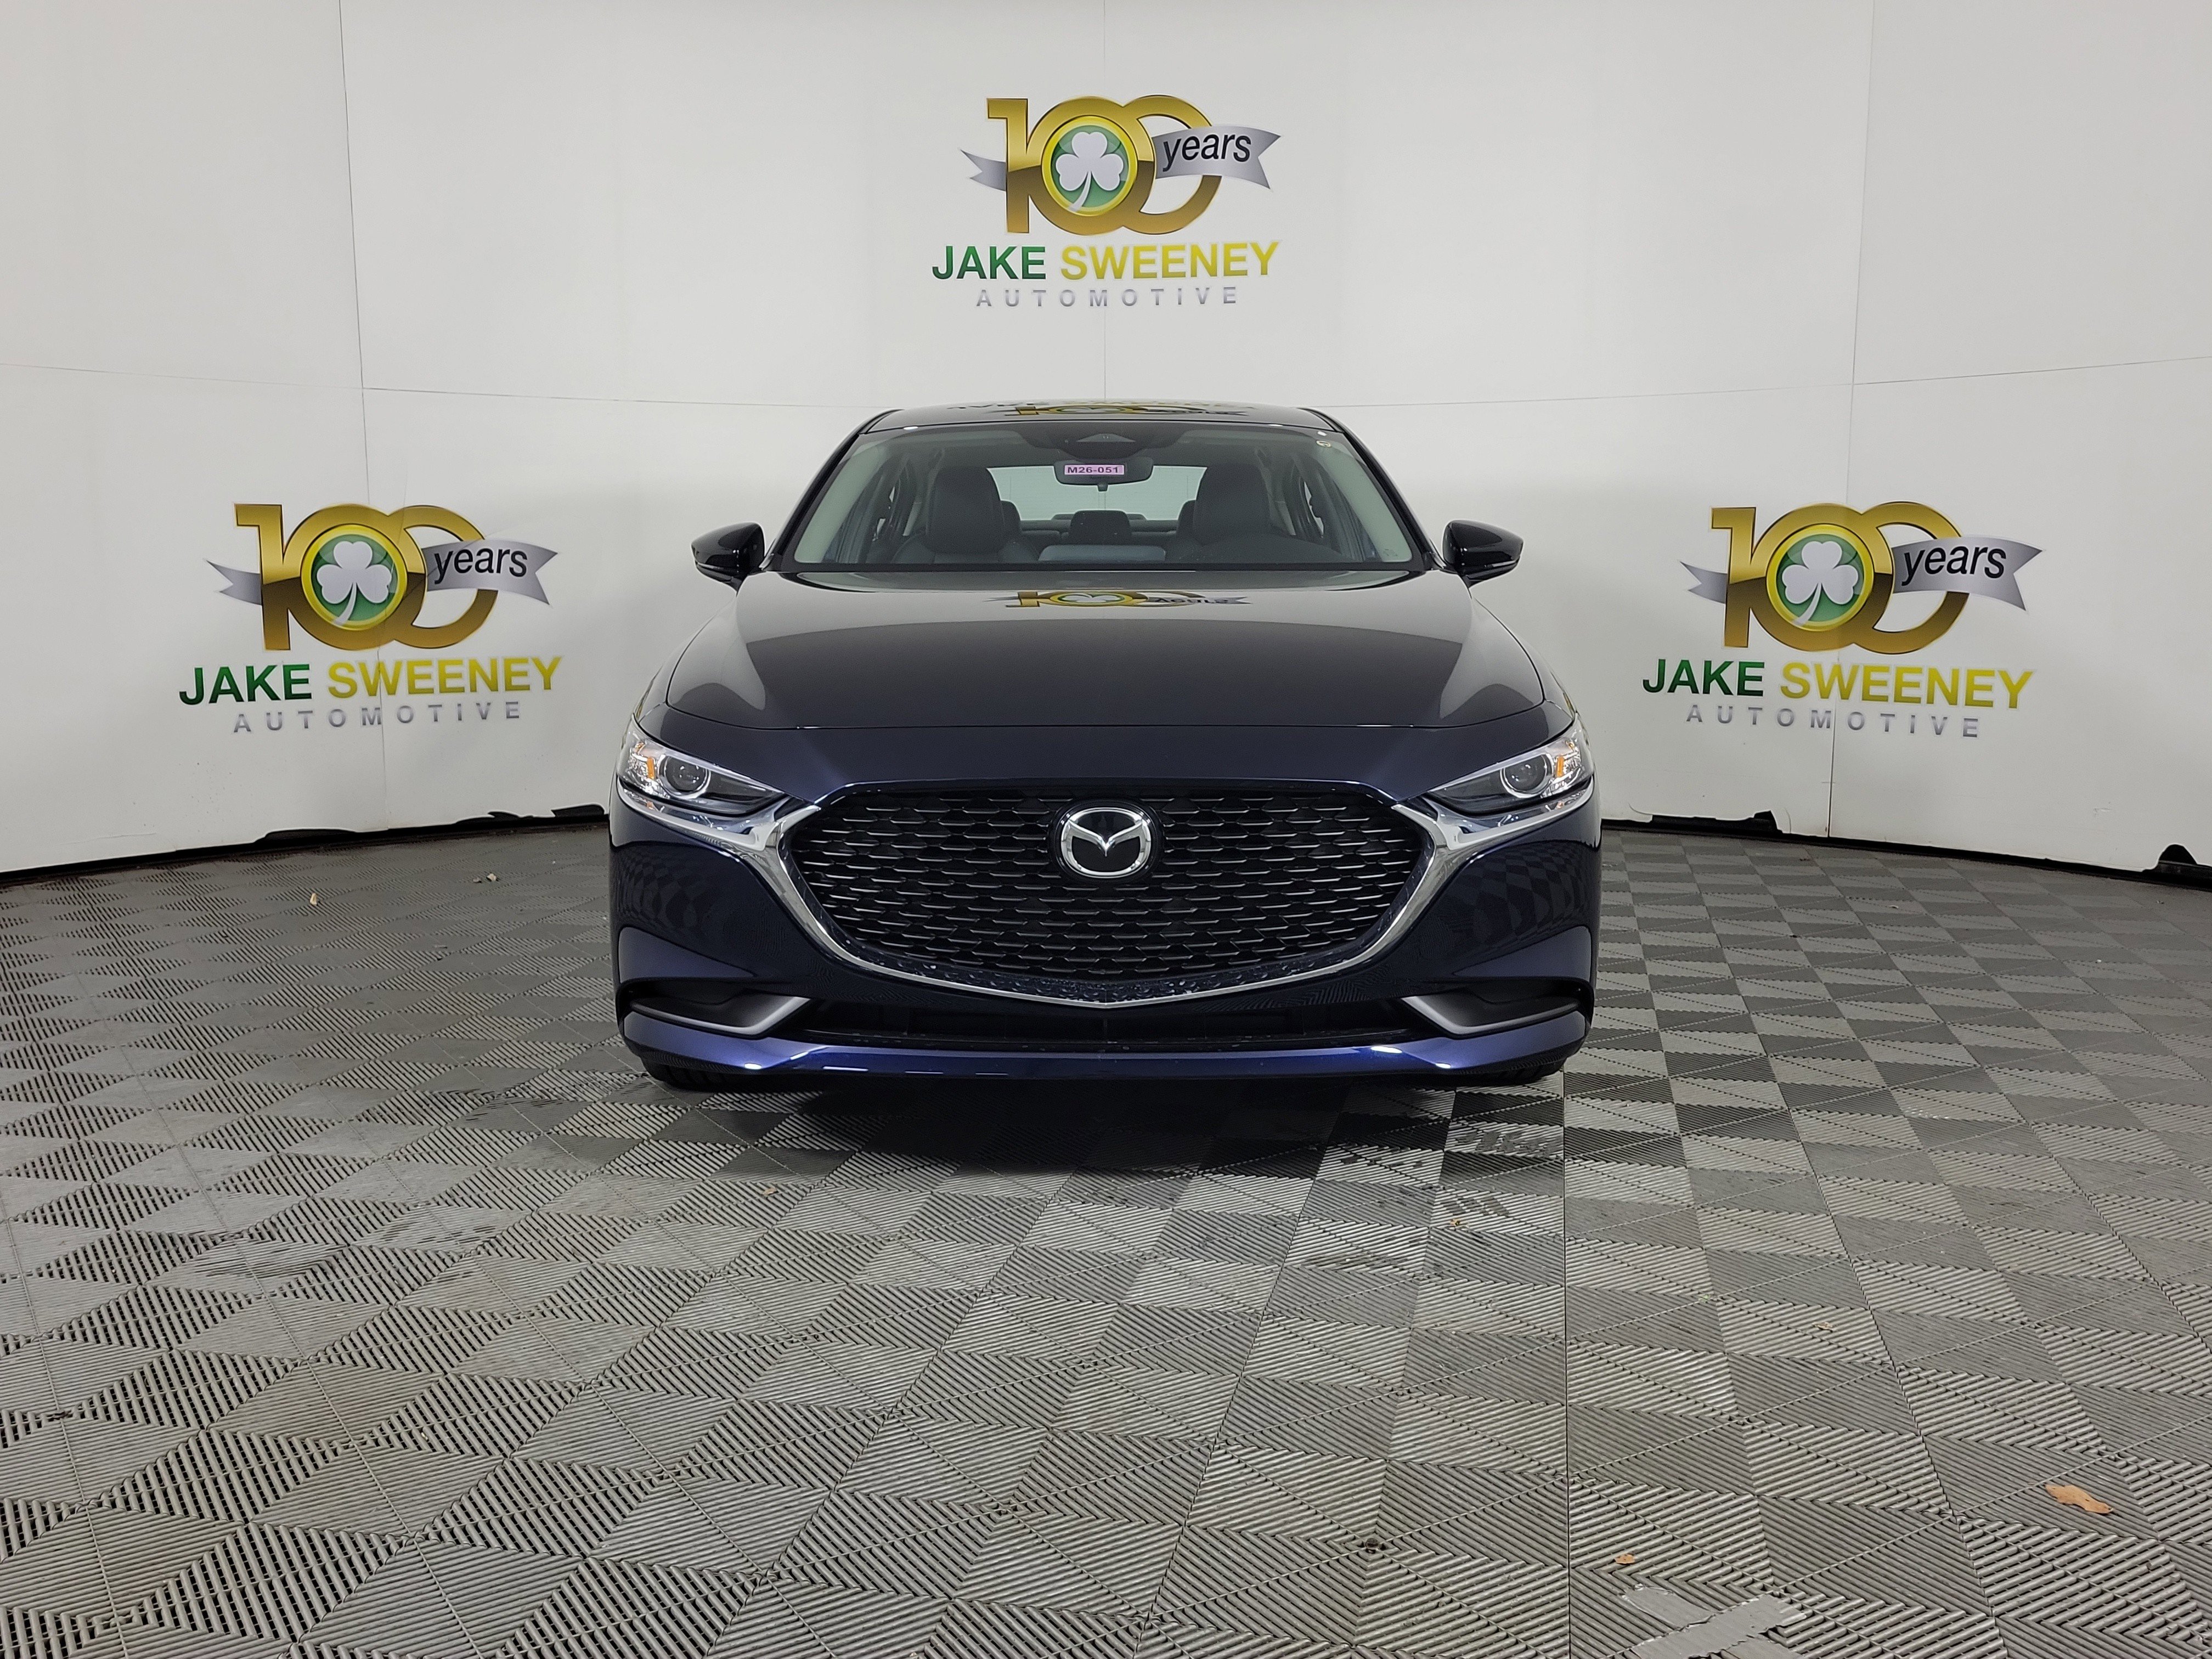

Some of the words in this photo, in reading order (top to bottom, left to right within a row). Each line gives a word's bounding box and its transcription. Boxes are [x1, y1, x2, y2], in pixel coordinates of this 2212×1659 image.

[987, 94, 1222, 235] 100
[1163, 132, 1252, 172] years
[932, 245, 1046, 280] JAKE
[1060, 241, 1279, 280] SWEENEY
[976, 286, 1237, 307] AUTOMOTIVE
[234, 504, 498, 651] 100
[433, 548, 528, 585] years
[1711, 501, 1970, 654] 100
[1901, 545, 2007, 586] years
[179, 663, 312, 706] JAKE
[328, 656, 563, 698] SWEENEY
[1643, 659, 1765, 697] JAKE
[1780, 662, 2033, 709] SWEENEY
[234, 701, 520, 733] AUTOMOTIVE
[1686, 704, 1978, 738] AUTOMOTIVE
